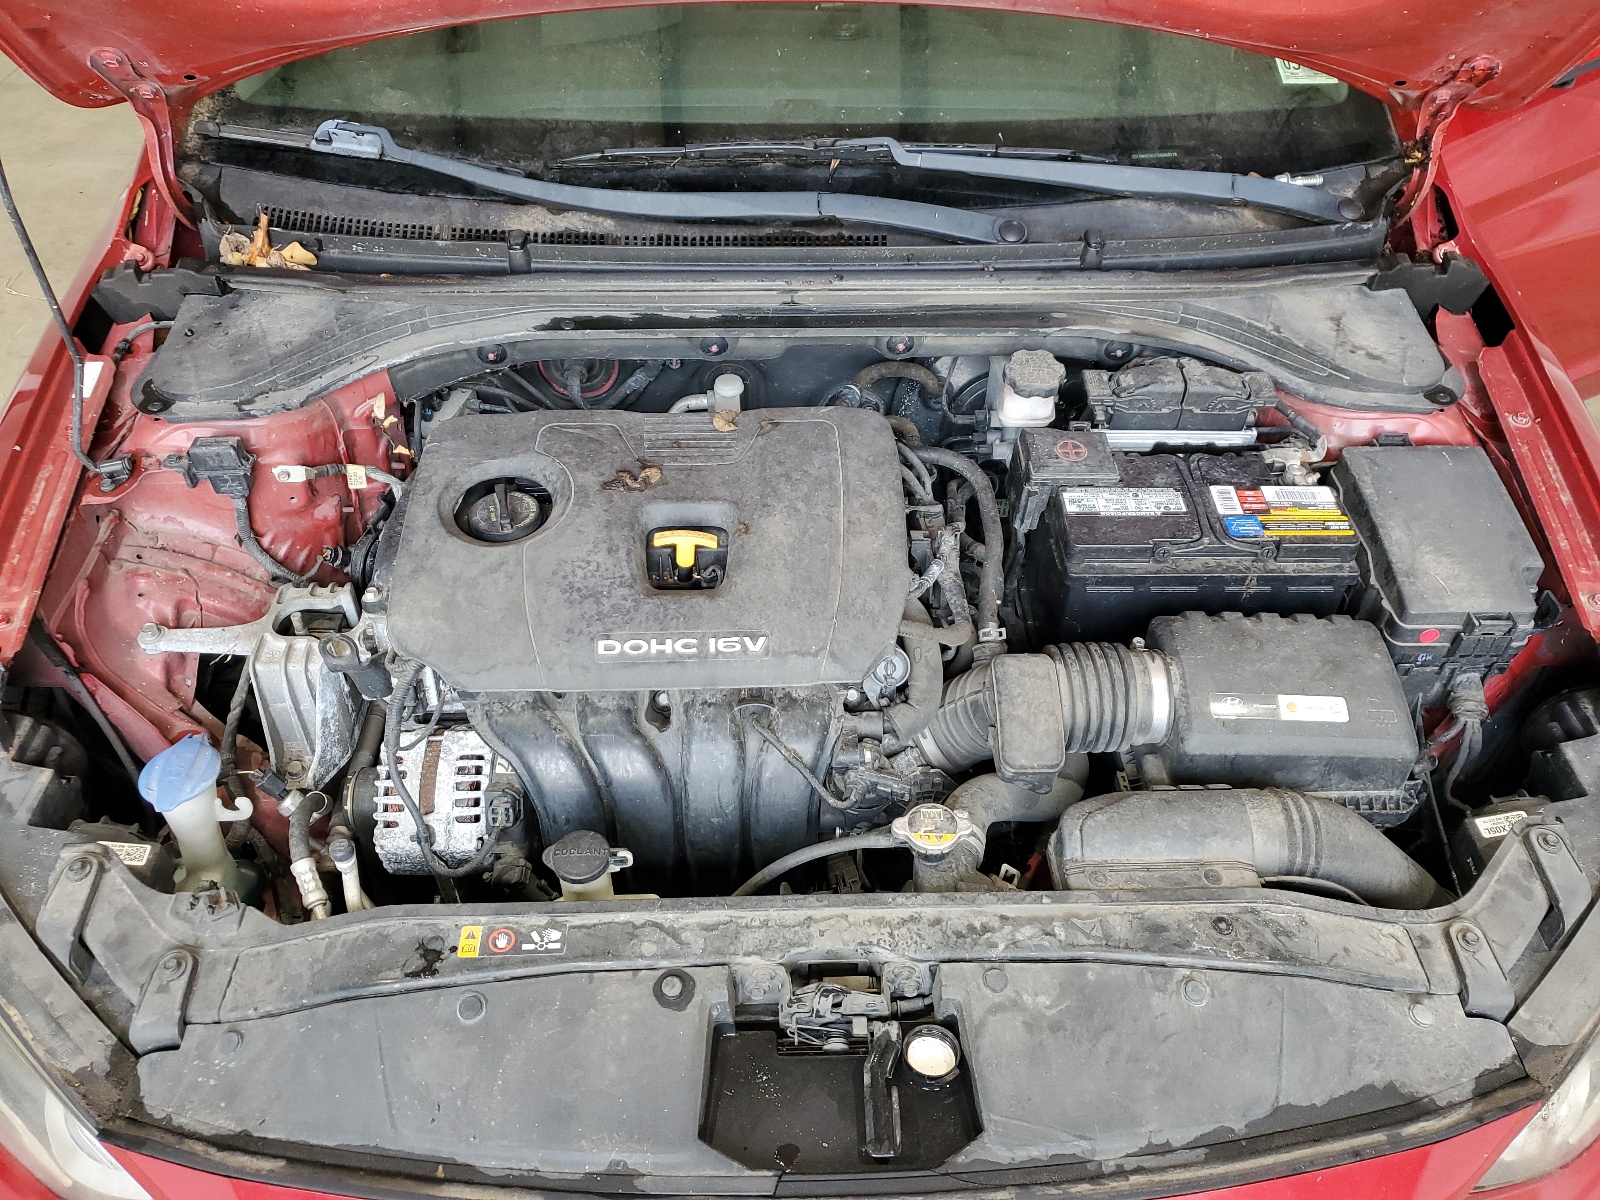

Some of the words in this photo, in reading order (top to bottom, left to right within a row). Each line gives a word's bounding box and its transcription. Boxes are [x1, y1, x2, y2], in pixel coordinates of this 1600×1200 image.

[597, 638, 699, 655] DOHC
[708, 636, 768, 654] 16V
[1483, 824, 1508, 835] X05L
[553, 847, 609, 857] COOLANT
